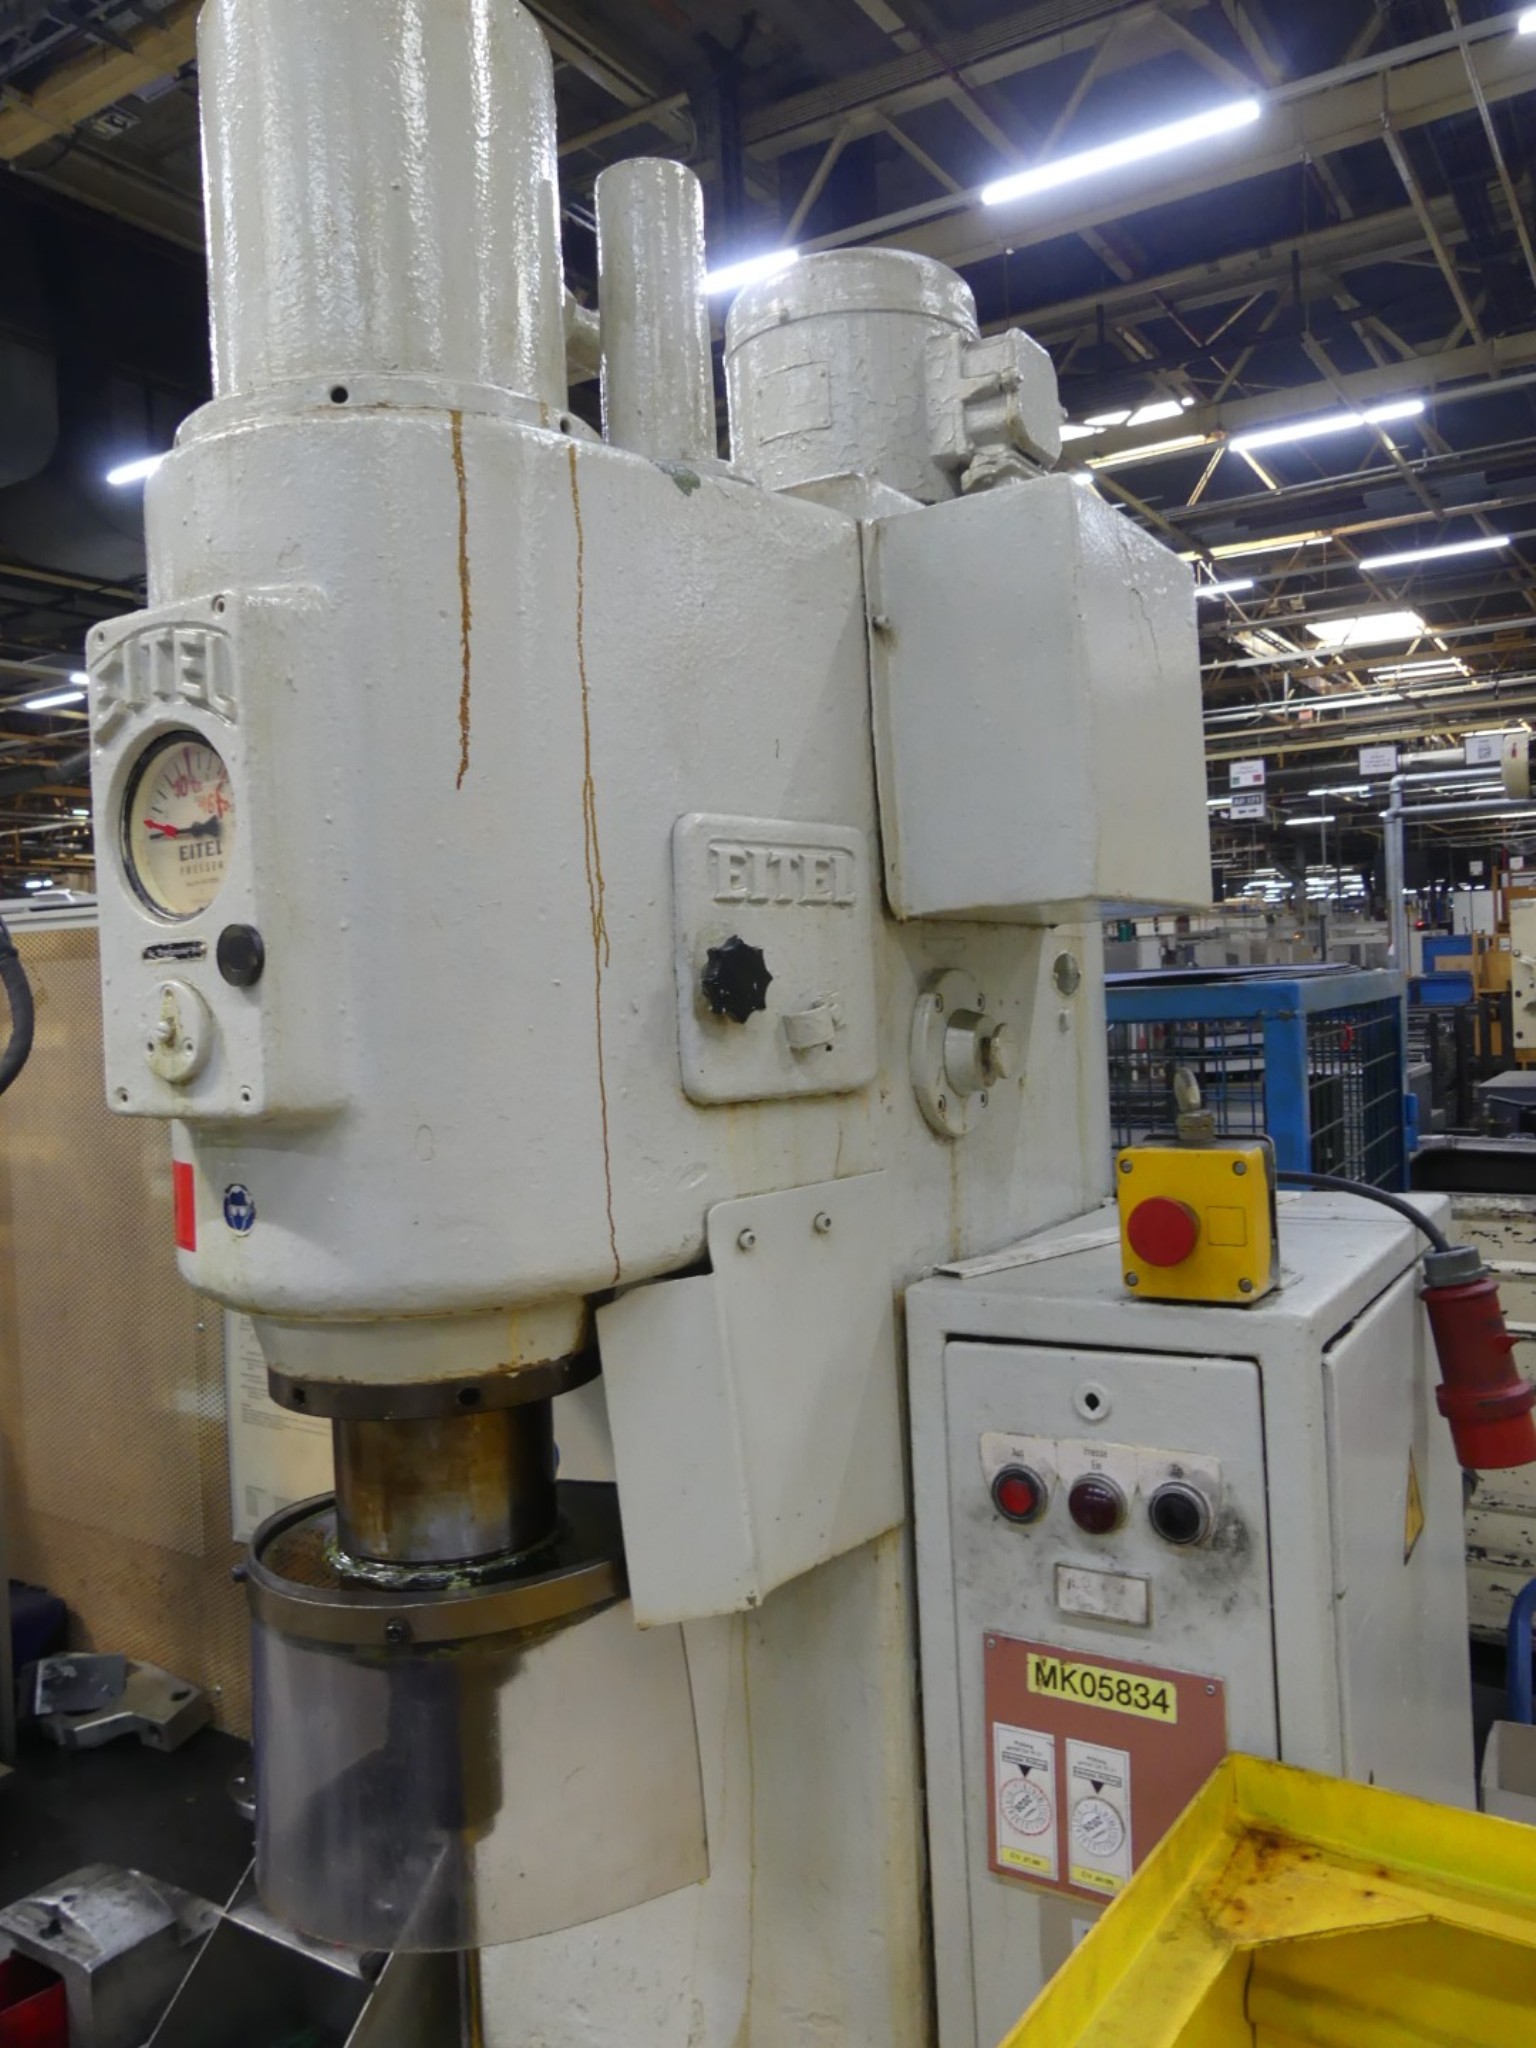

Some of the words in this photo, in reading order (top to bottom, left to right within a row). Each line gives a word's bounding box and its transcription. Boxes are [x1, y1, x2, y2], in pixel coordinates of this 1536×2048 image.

[178, 840, 222, 861] EITEL
[709, 844, 856, 907] EITEL
[1035, 1661, 1170, 1714] MK05834
